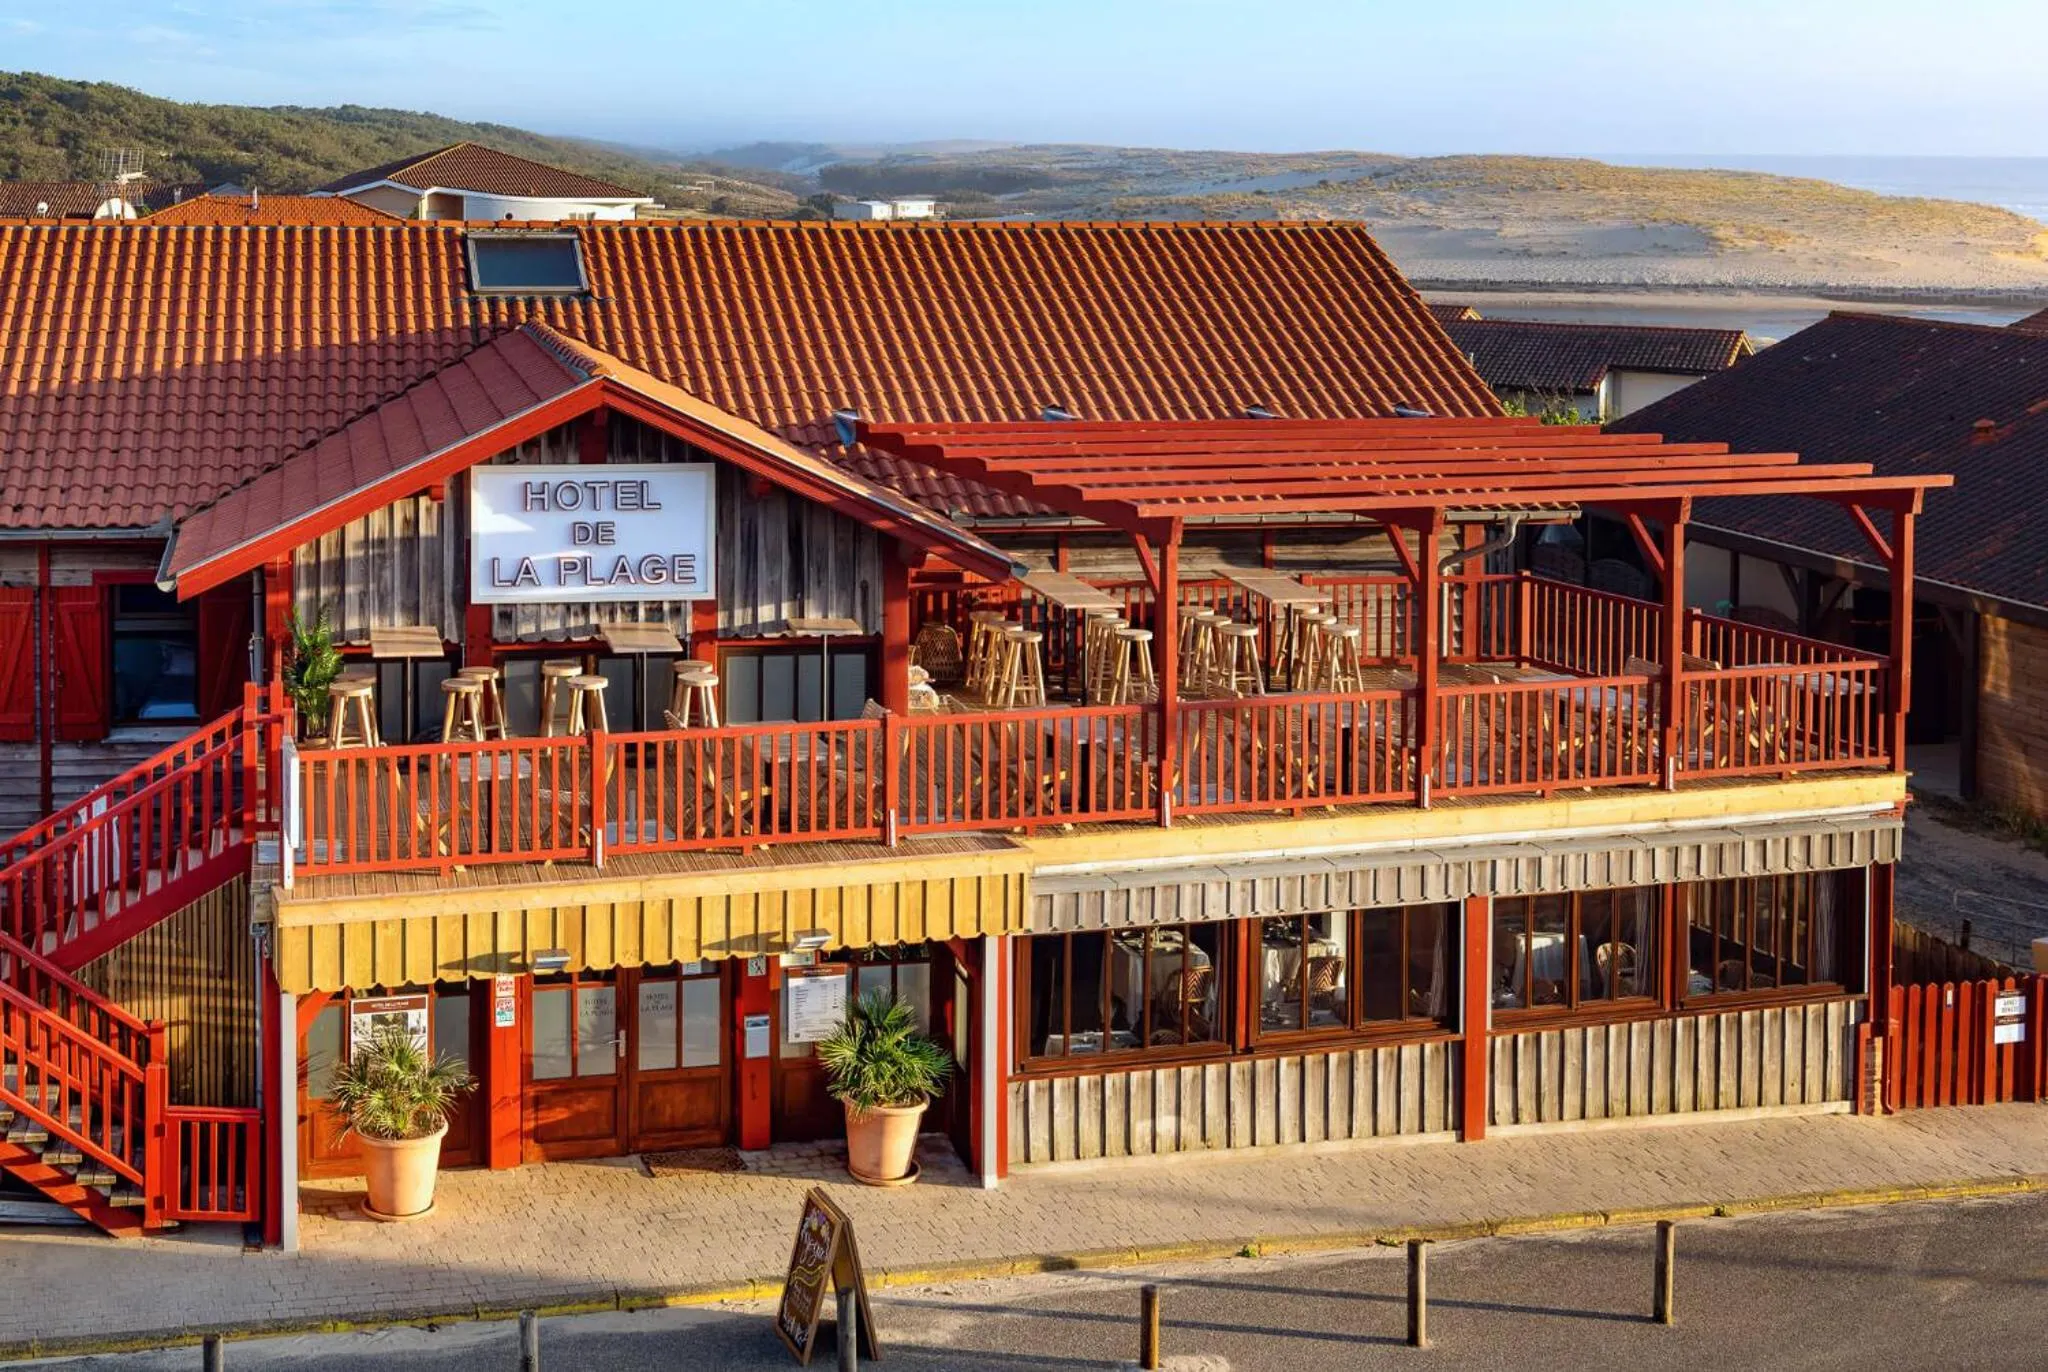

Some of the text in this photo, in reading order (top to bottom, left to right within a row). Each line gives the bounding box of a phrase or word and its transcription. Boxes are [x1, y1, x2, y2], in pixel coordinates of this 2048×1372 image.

[524, 480, 662, 512] HOTEL
[572, 521, 616, 546] DE
[491, 553, 697, 588] LA PLAGE
